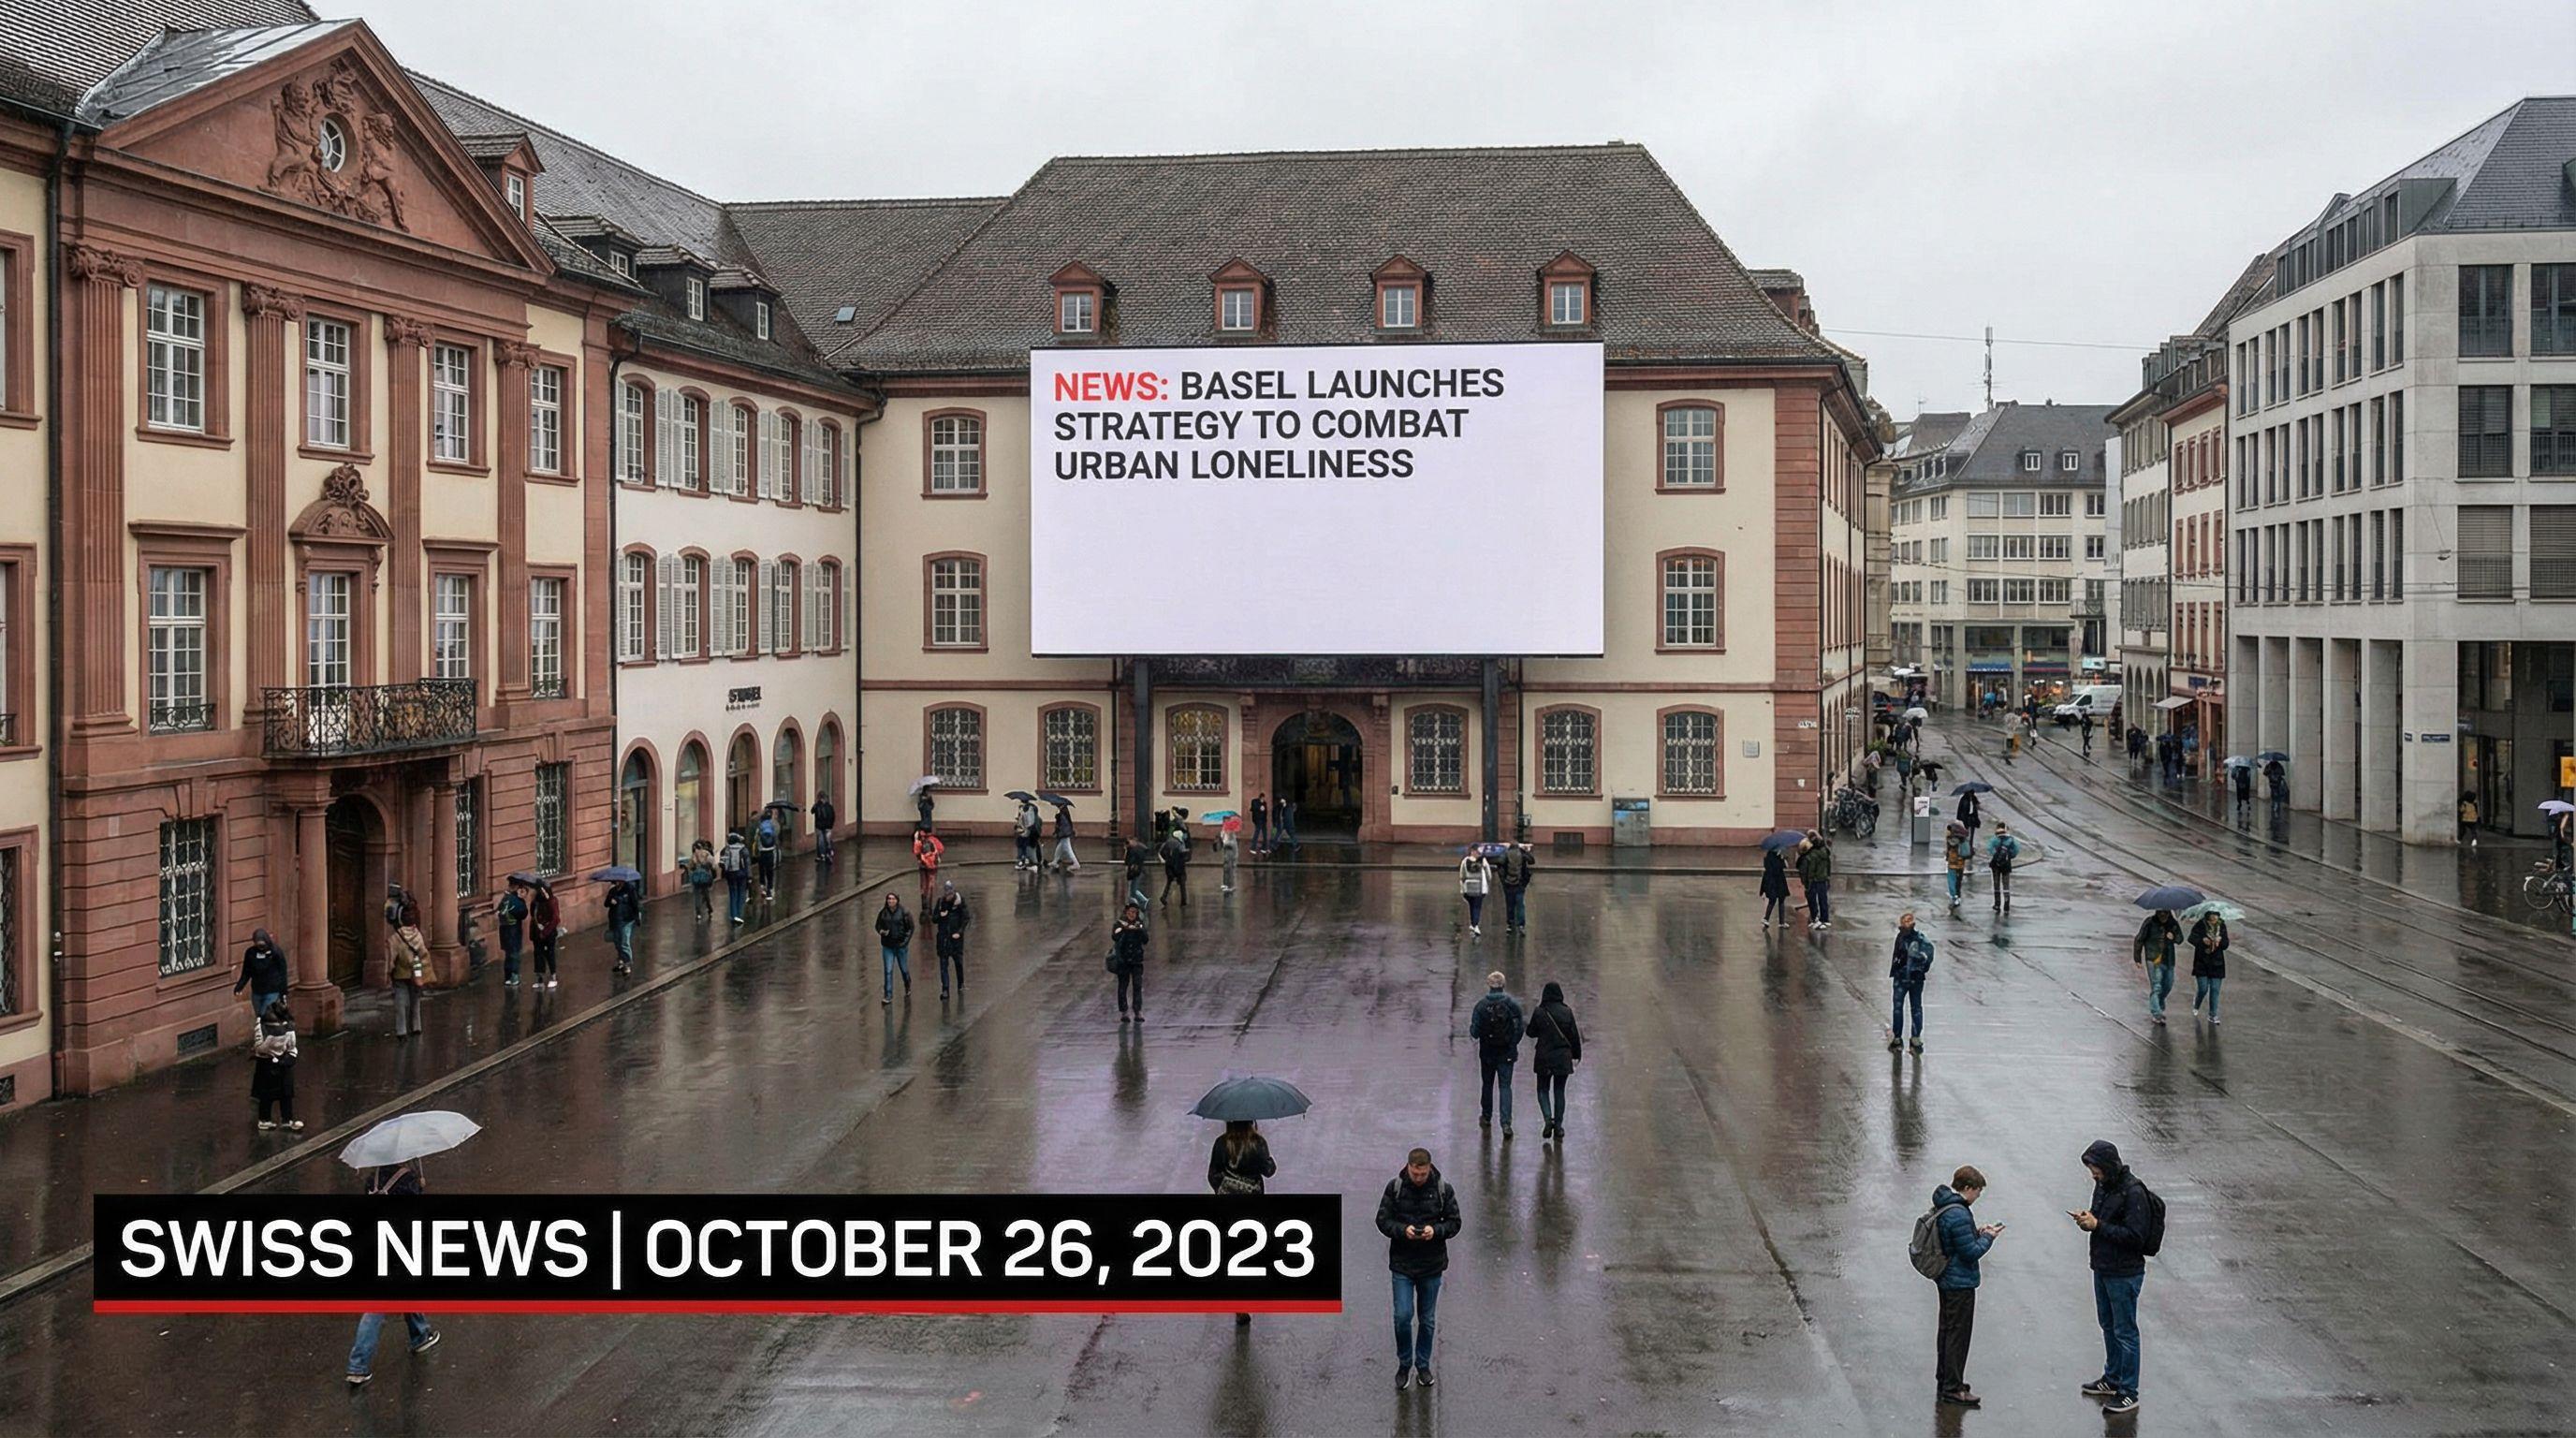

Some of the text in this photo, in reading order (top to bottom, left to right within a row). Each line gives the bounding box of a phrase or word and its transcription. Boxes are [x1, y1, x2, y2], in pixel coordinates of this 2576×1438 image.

[1054, 368, 1505, 402] NEWS: BASEL LAUNCHES
[1054, 408, 1470, 441] STRATEGY TO COMBAT
[1055, 448, 1414, 480] URBAN LONELINESS
